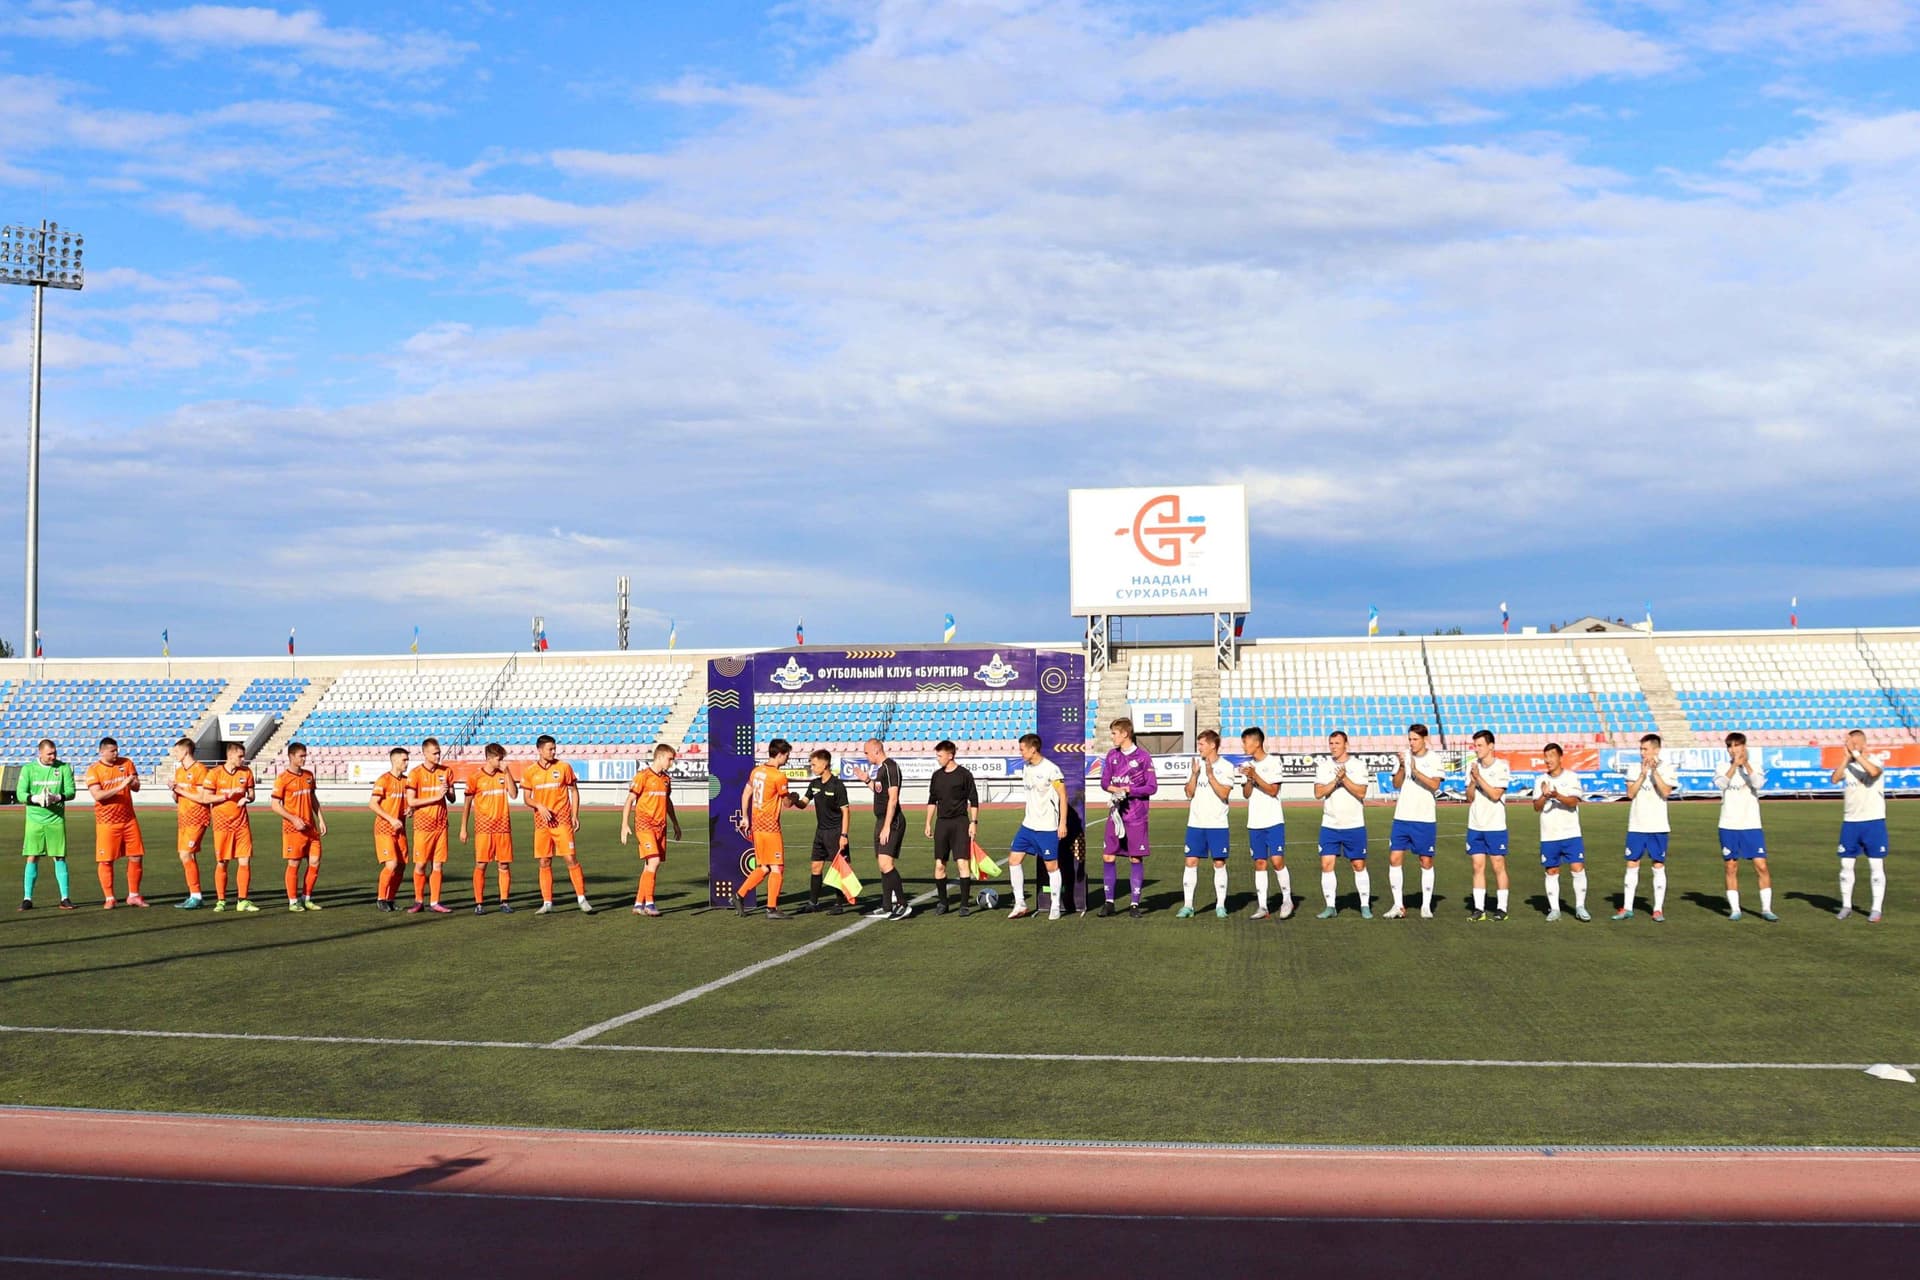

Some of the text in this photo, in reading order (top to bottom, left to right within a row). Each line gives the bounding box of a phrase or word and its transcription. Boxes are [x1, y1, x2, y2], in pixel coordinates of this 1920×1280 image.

[1131, 574, 1191, 586] НААДАН
[1116, 587, 1208, 599] СУРХАРБААН
[817, 665, 969, 679] ФУТБОЛЬНЫЙ КЛУБ «БУРЯТИЯ»
